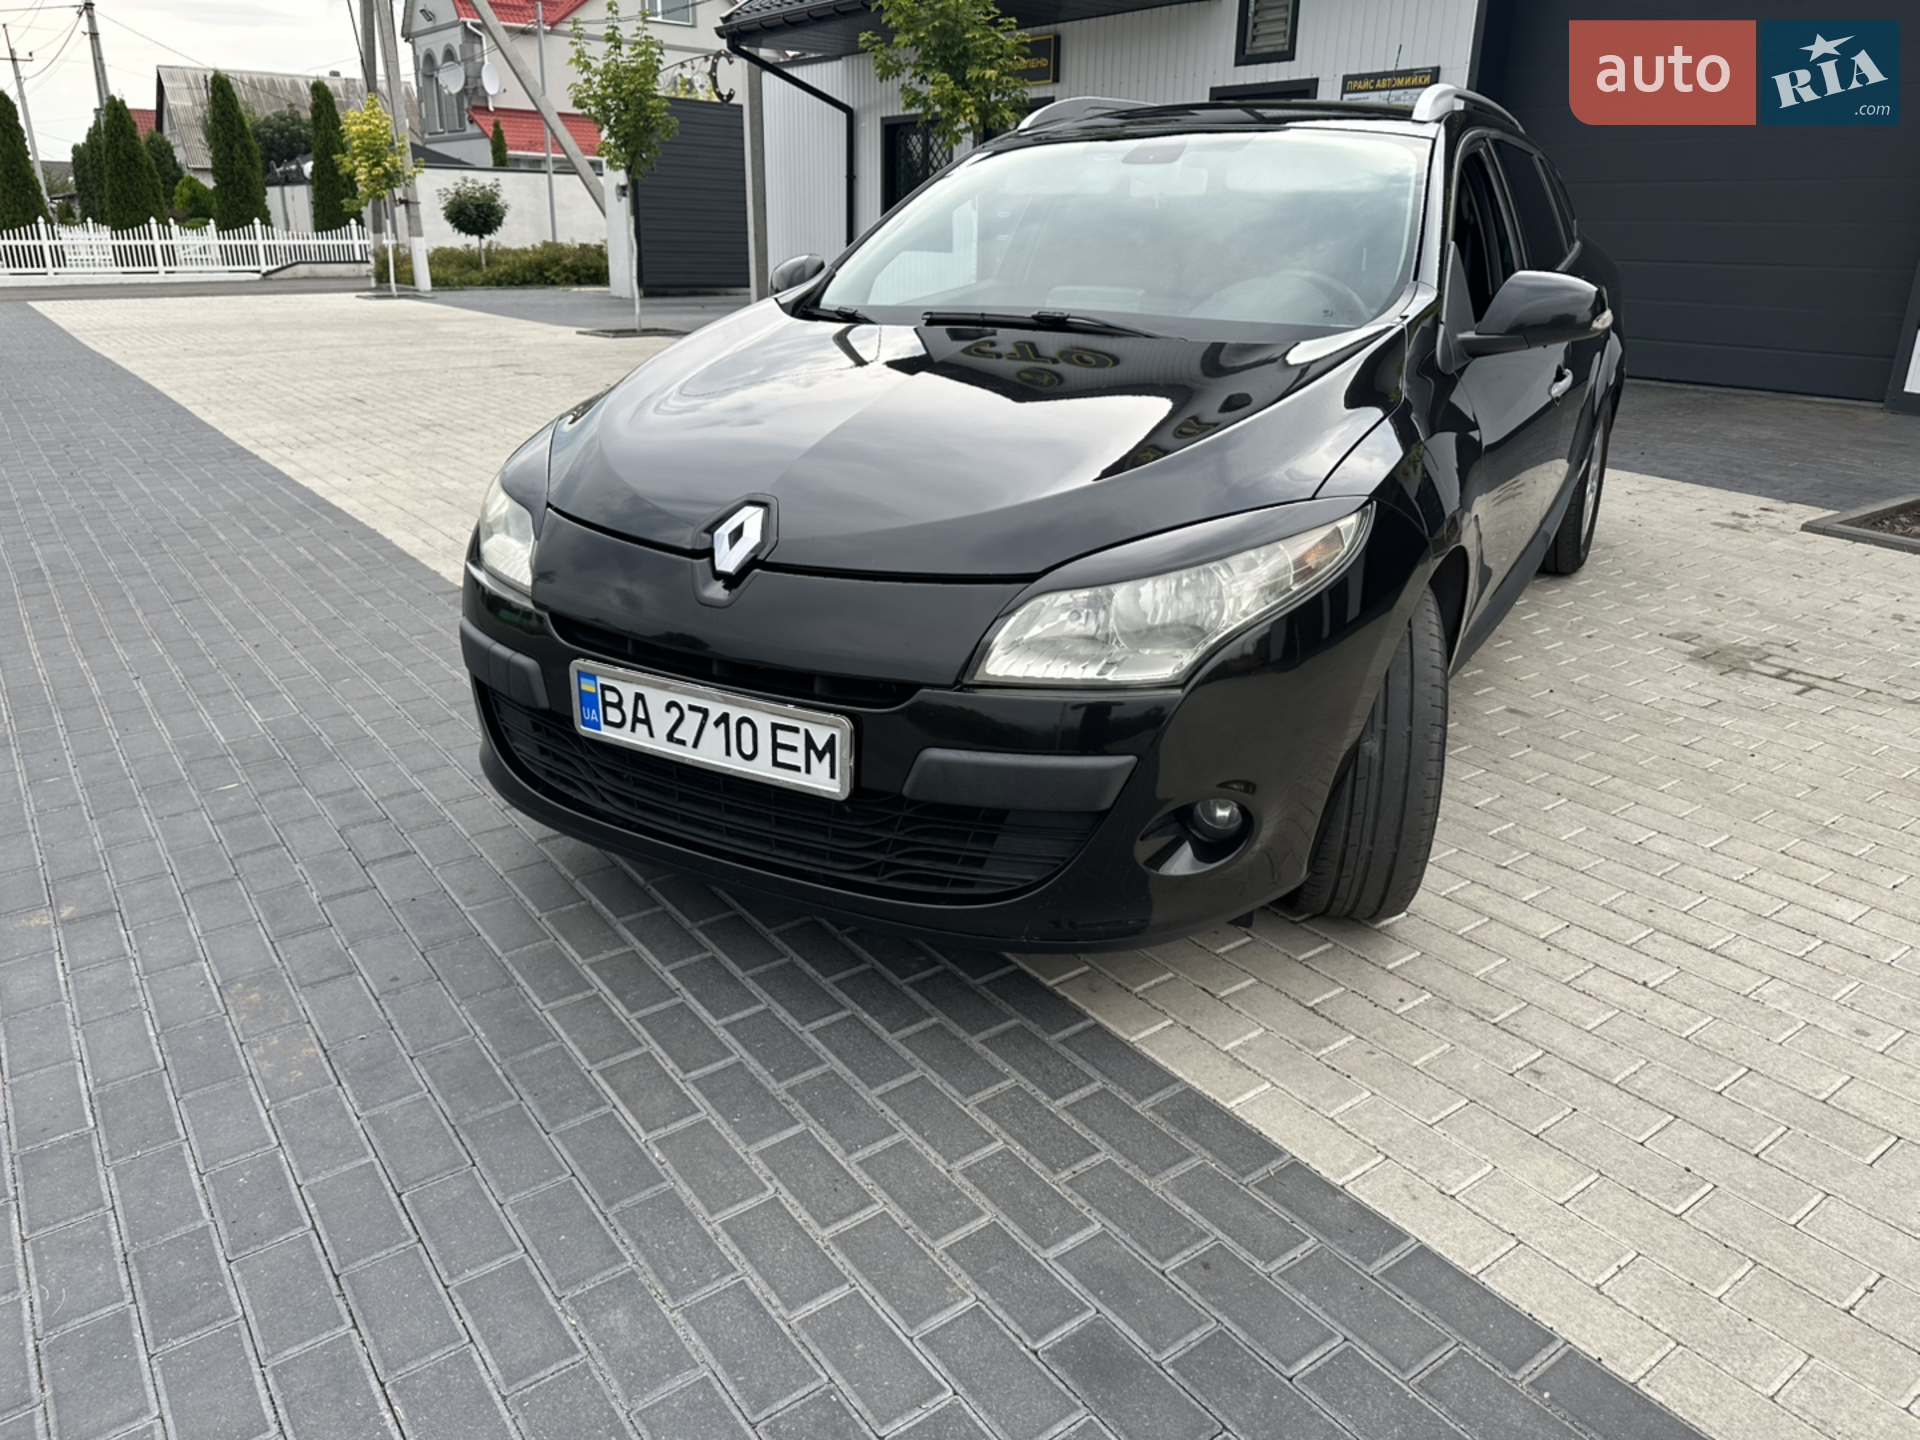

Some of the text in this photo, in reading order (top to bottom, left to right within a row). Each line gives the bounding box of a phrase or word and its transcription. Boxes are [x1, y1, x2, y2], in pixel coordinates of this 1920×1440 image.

[1346, 74, 1431, 91] ПРАЙС АВТОМИЙКИ
[582, 708, 599, 722] UA
[600, 683, 837, 780] BA 2710 EM
